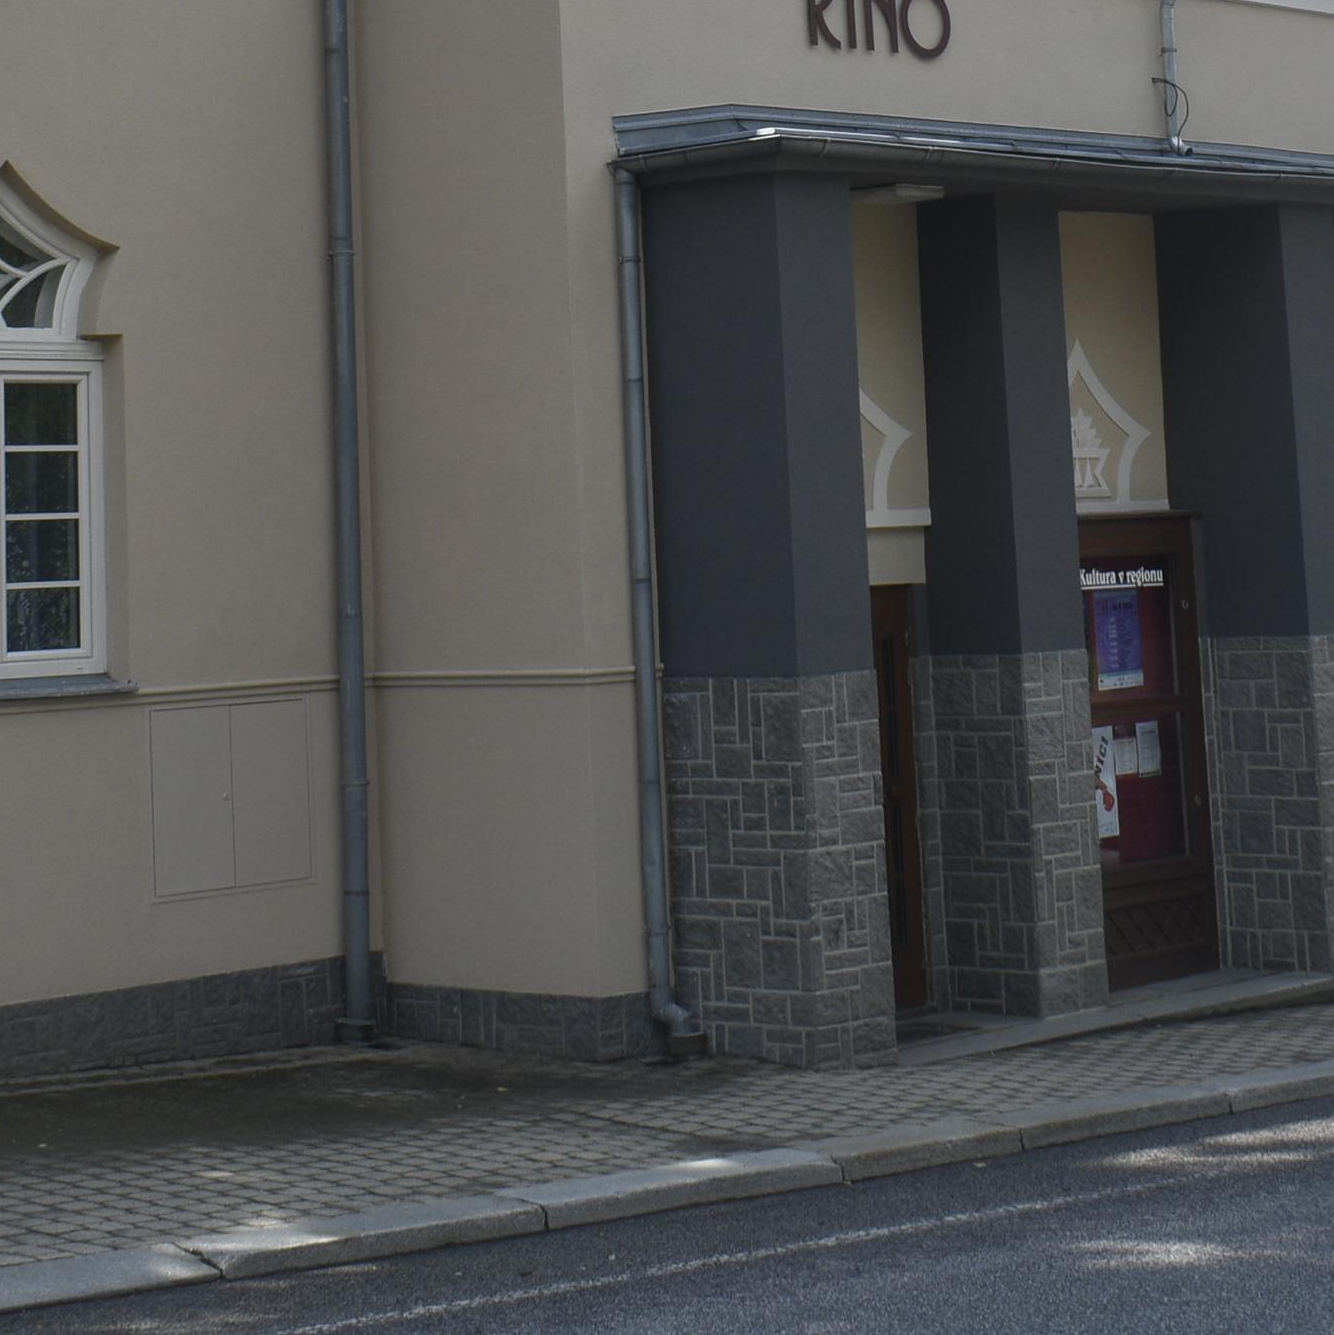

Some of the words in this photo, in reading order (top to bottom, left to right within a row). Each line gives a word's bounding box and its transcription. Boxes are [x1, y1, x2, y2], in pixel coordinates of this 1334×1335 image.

[1079, 568, 1116, 585] Kultura
[1118, 571, 1124, 583] v
[1126, 566, 1163, 586] regionu
